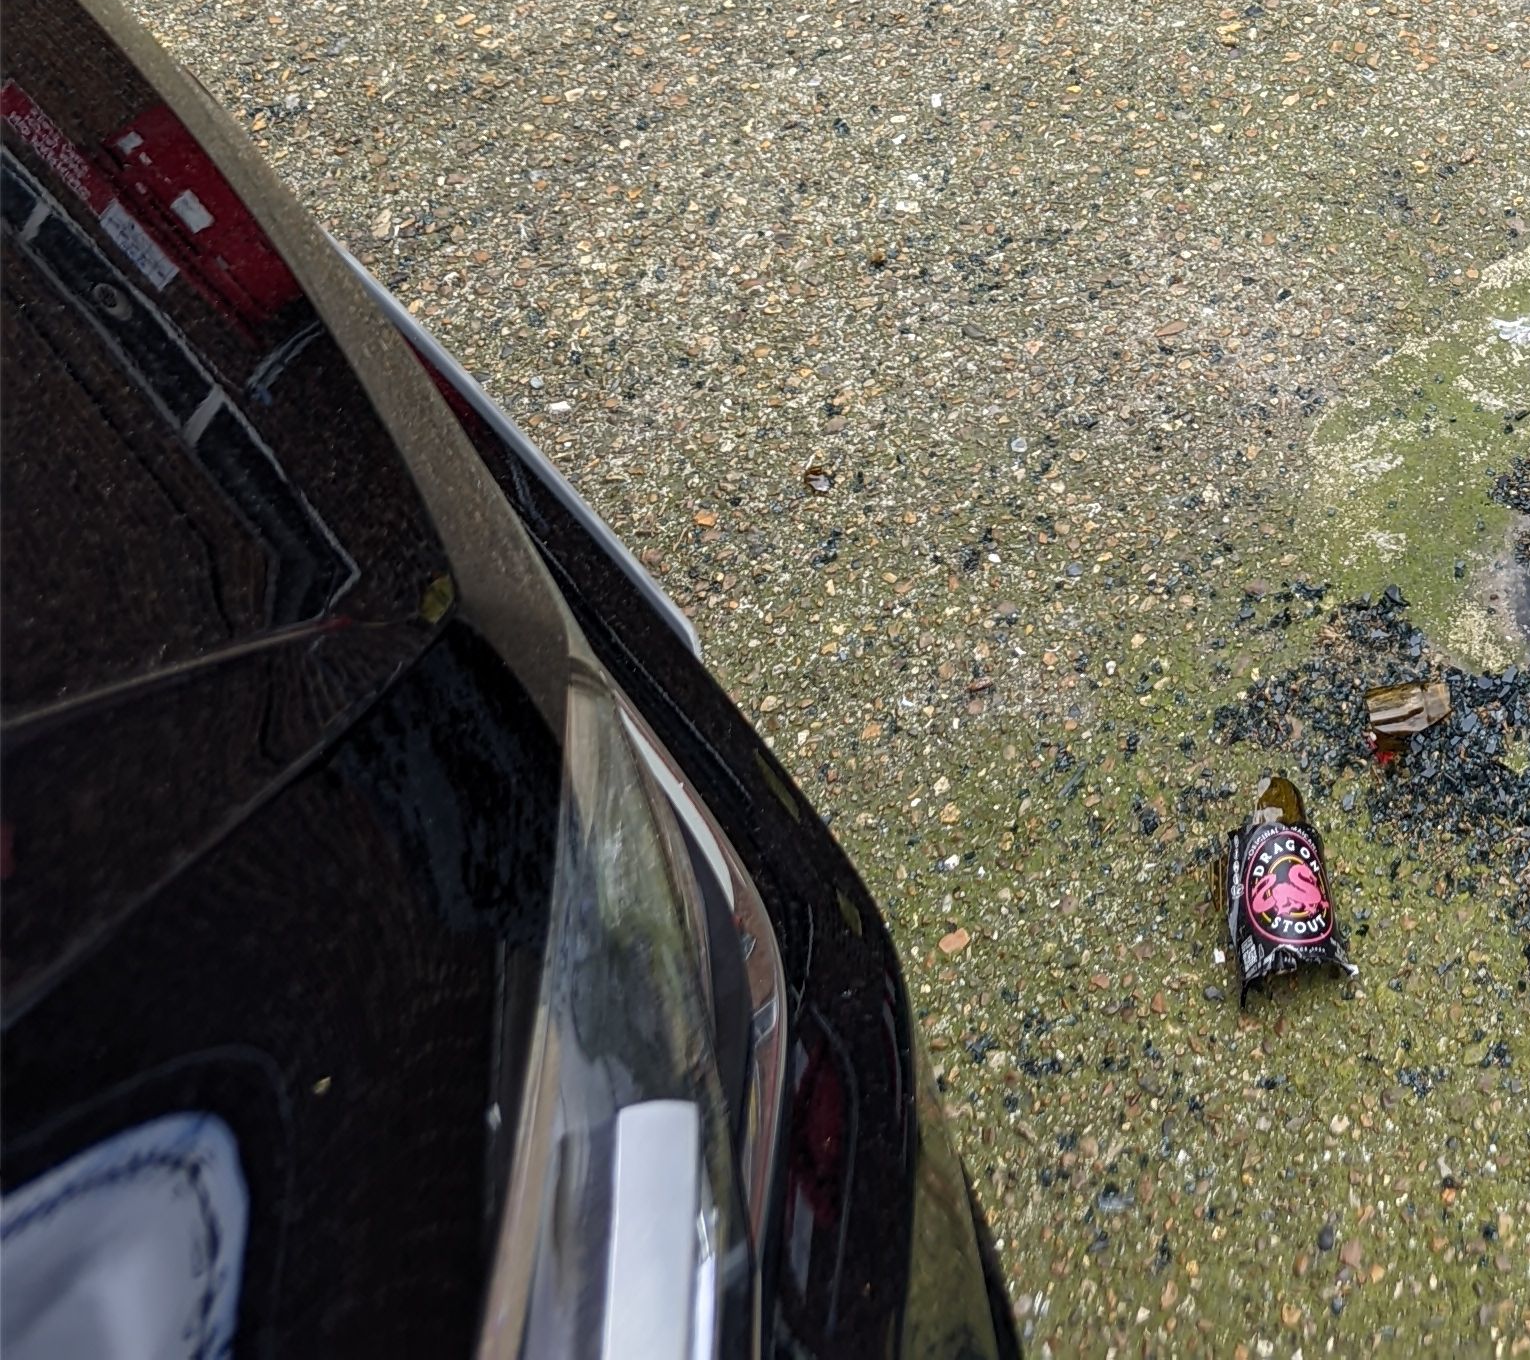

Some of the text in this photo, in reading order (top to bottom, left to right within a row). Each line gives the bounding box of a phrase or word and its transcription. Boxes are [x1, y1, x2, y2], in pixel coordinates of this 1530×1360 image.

[1249, 827, 1279, 857] ORIGINAL
[1253, 840, 1320, 877] DRAGON
[1271, 914, 1326, 934] STOUT
